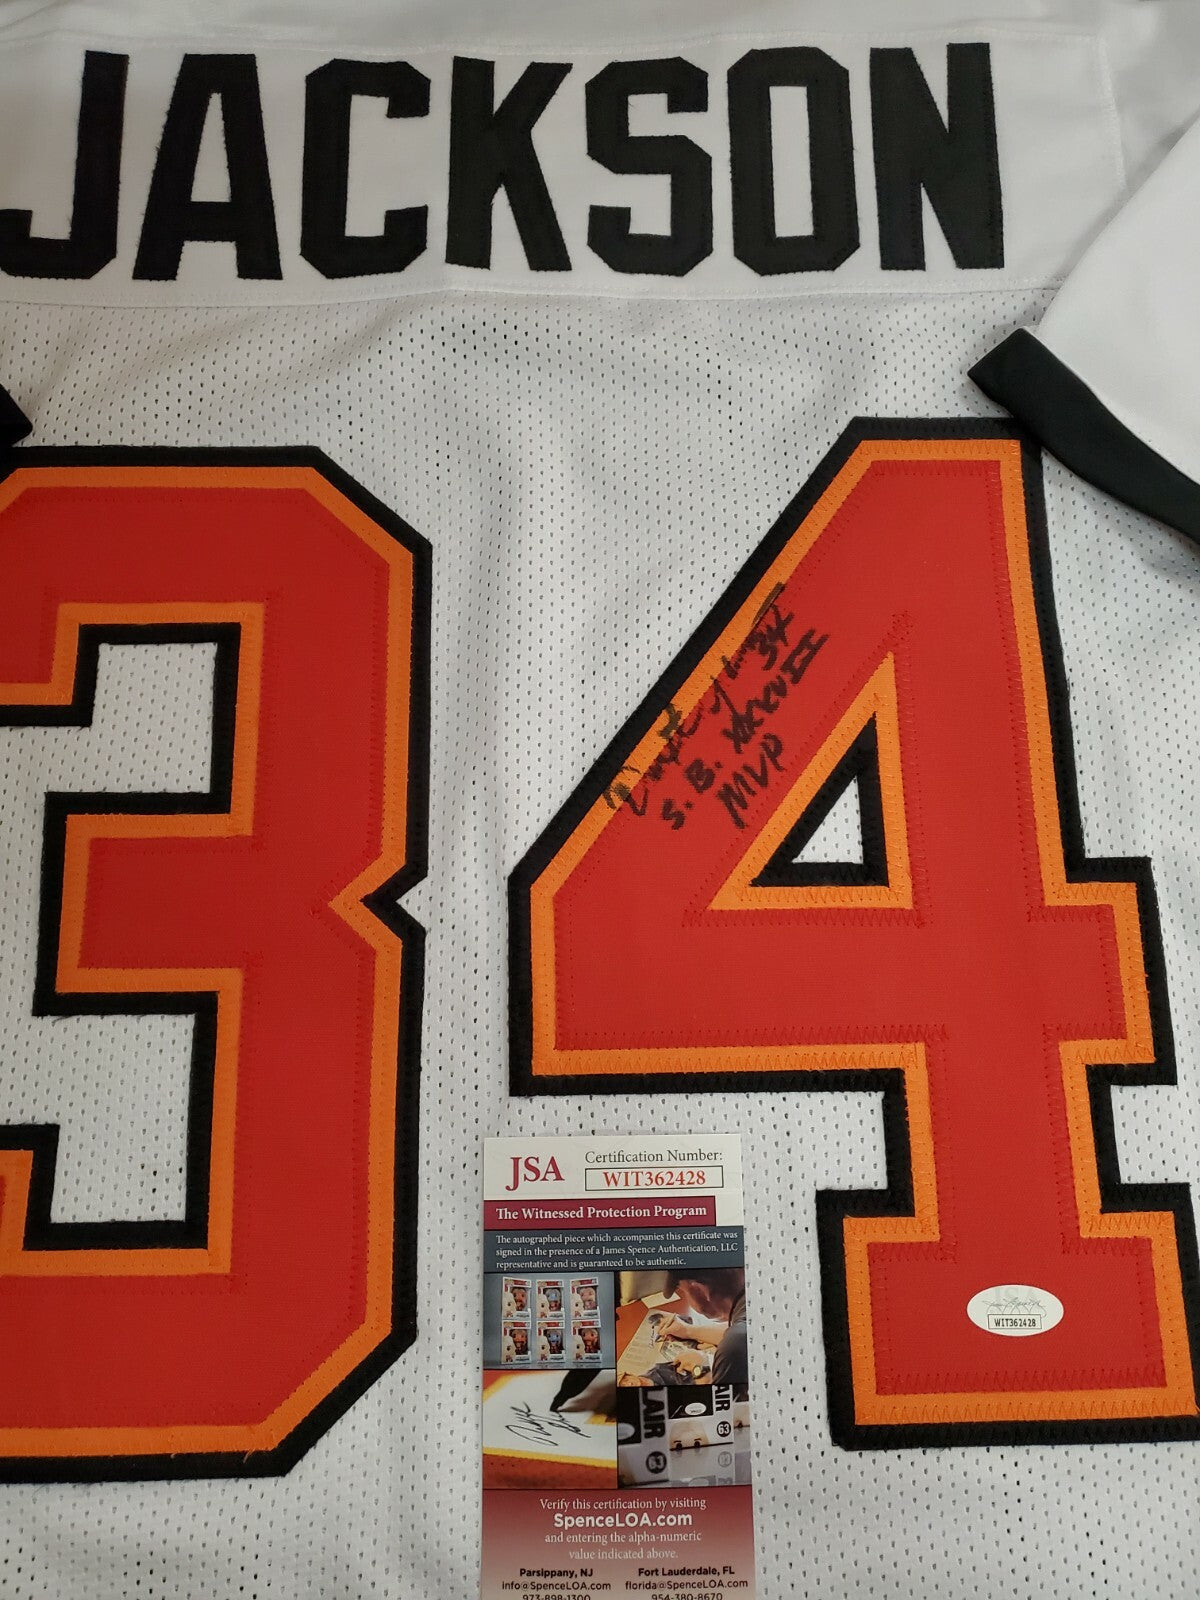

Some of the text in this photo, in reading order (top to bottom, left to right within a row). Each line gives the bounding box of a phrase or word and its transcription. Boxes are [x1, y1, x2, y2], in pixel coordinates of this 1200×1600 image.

[0, 42, 1005, 281] JACKSON
[717, 733, 784, 830] MVP
[585, 1148, 723, 1164] Certification Number:
[505, 1155, 565, 1192] JSA
[603, 1170, 706, 1188] WIT362428
[496, 1205, 707, 1220] The Witnessed Protection Program
[496, 1235, 511, 1244] The
[512, 1234, 562, 1246] autographed
[564, 1234, 586, 1245] piece
[587, 1233, 611, 1242] which
[613, 1232, 664, 1243] accompanies
[666, 1231, 681, 1241] this
[682, 1230, 722, 1240] certificate
[496, 1247, 522, 1258] signed
[524, 1247, 532, 1256] in
[534, 1246, 547, 1256] the
[549, 1247, 584, 1257] presence
[585, 1245, 595, 1255] of
[602, 1245, 626, 1256] James
[627, 1245, 656, 1256] Spence
[658, 1243, 719, 1253] Authentication,
[720, 1242, 738, 1252] LLC
[496, 1256, 687, 1271] representative and is guaranteed to be authentic.
[994, 1318, 1037, 1328] WIT362428
[717, 1422, 730, 1436] 63
[540, 1497, 707, 1513] Verify this certification by visiting
[554, 1512, 693, 1530] SpenceLOA.com
[545, 1530, 702, 1546] and entering the alpha-numeric
[569, 1547, 679, 1560] value indicated above.
[519, 1567, 594, 1579] Parsippany, NJ
[638, 1565, 735, 1577] Fort Lauderdale, FL
[502, 1581, 612, 1592] info@SpenceLOA.com
[625, 1579, 748, 1591] florida@SpenceLOA.com
